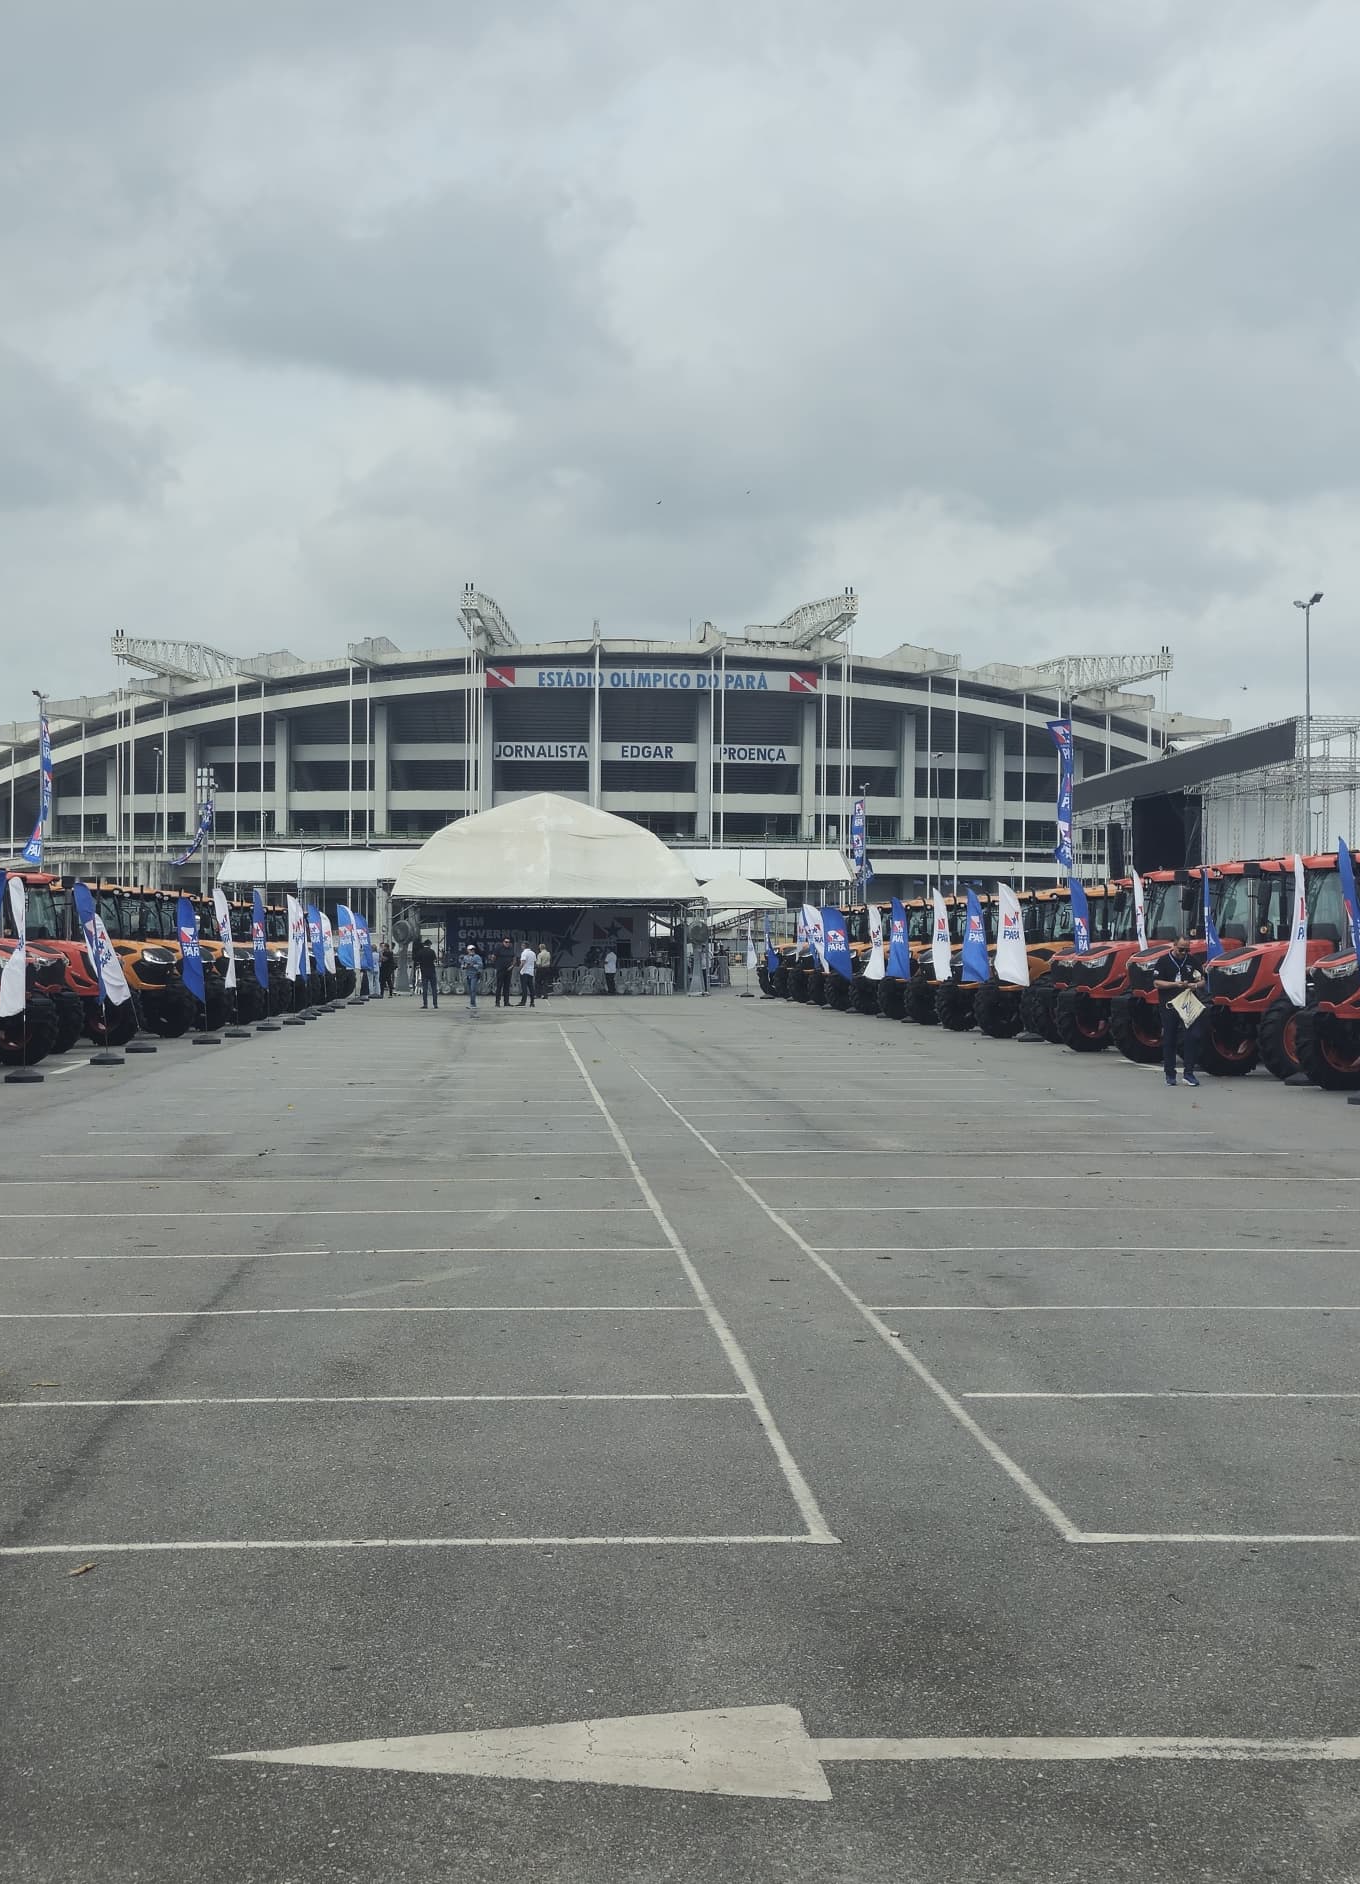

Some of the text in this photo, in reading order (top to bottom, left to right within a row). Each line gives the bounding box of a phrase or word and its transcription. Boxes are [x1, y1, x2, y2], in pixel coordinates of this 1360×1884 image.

[538, 669, 768, 690] ESTÁDIO OLÍMPICO DO PARÁ
[495, 744, 588, 758] JORNALISTA
[621, 745, 674, 759] EDGAR
[719, 747, 786, 763] PROENÇA
[457, 916, 484, 927] TEM
